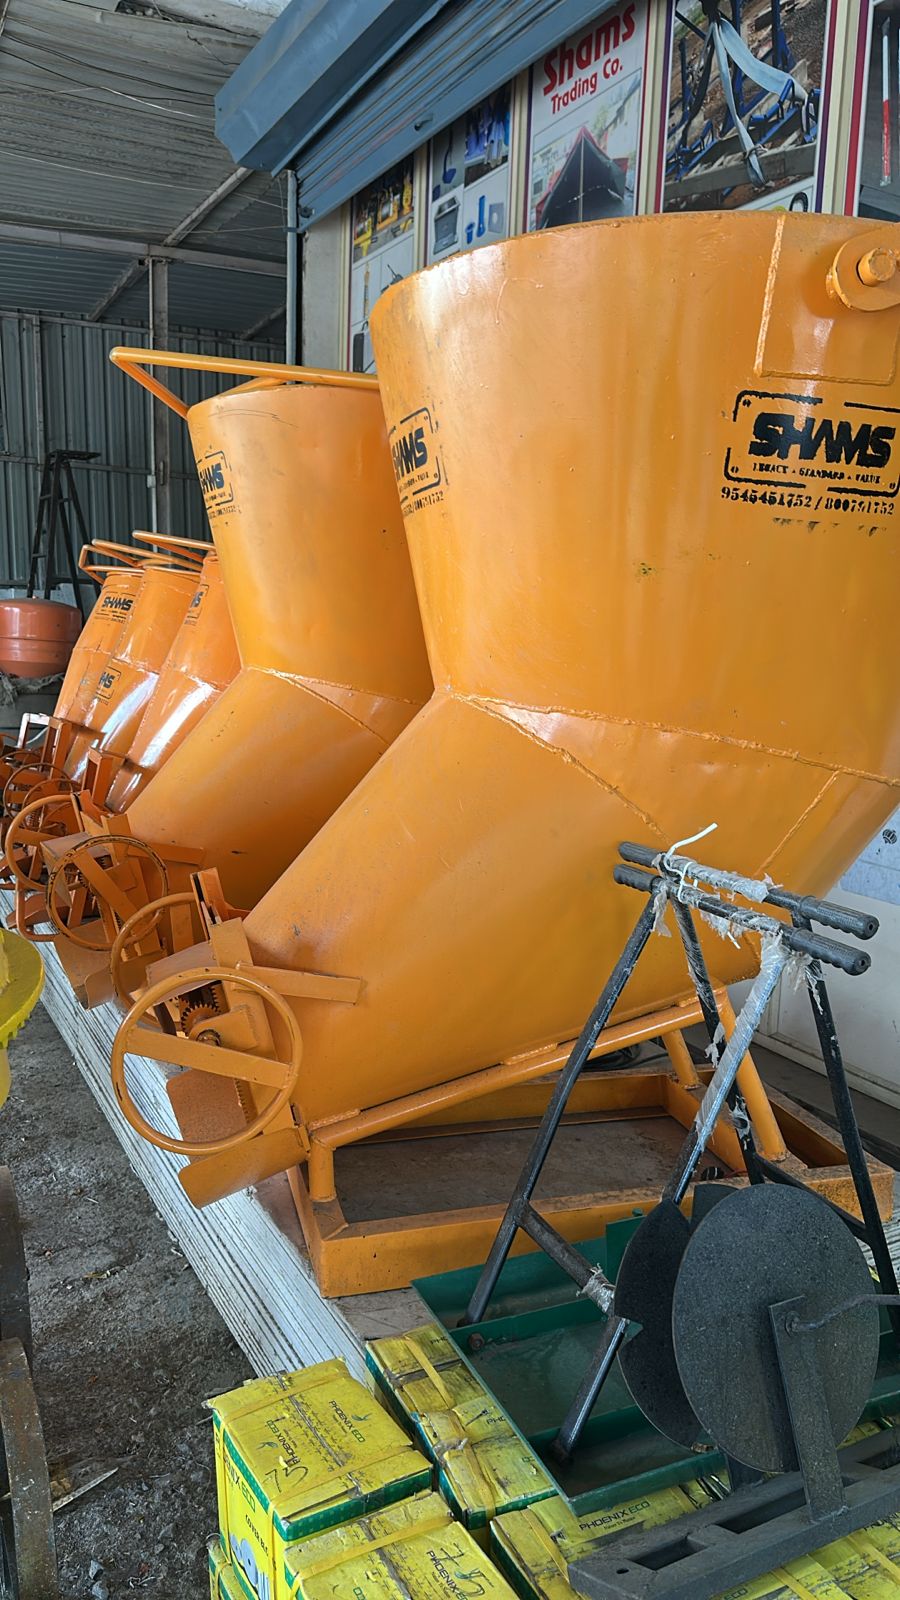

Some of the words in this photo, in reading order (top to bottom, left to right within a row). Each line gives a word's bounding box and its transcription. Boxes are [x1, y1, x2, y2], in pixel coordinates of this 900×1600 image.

[543, 3, 636, 97] Shams
[551, 72, 598, 115] Trading
[602, 58, 623, 80] Co.
[749, 412, 896, 468] SHAMS
[102, 596, 134, 611] SHAMS
[329, 1400, 353, 1430] PHOENIX
[351, 1429, 366, 1443] ECO
[579, 1509, 629, 1531] PHOENIX
[628, 1501, 650, 1514] ECO
[426, 1550, 457, 1593] PHOENIX
